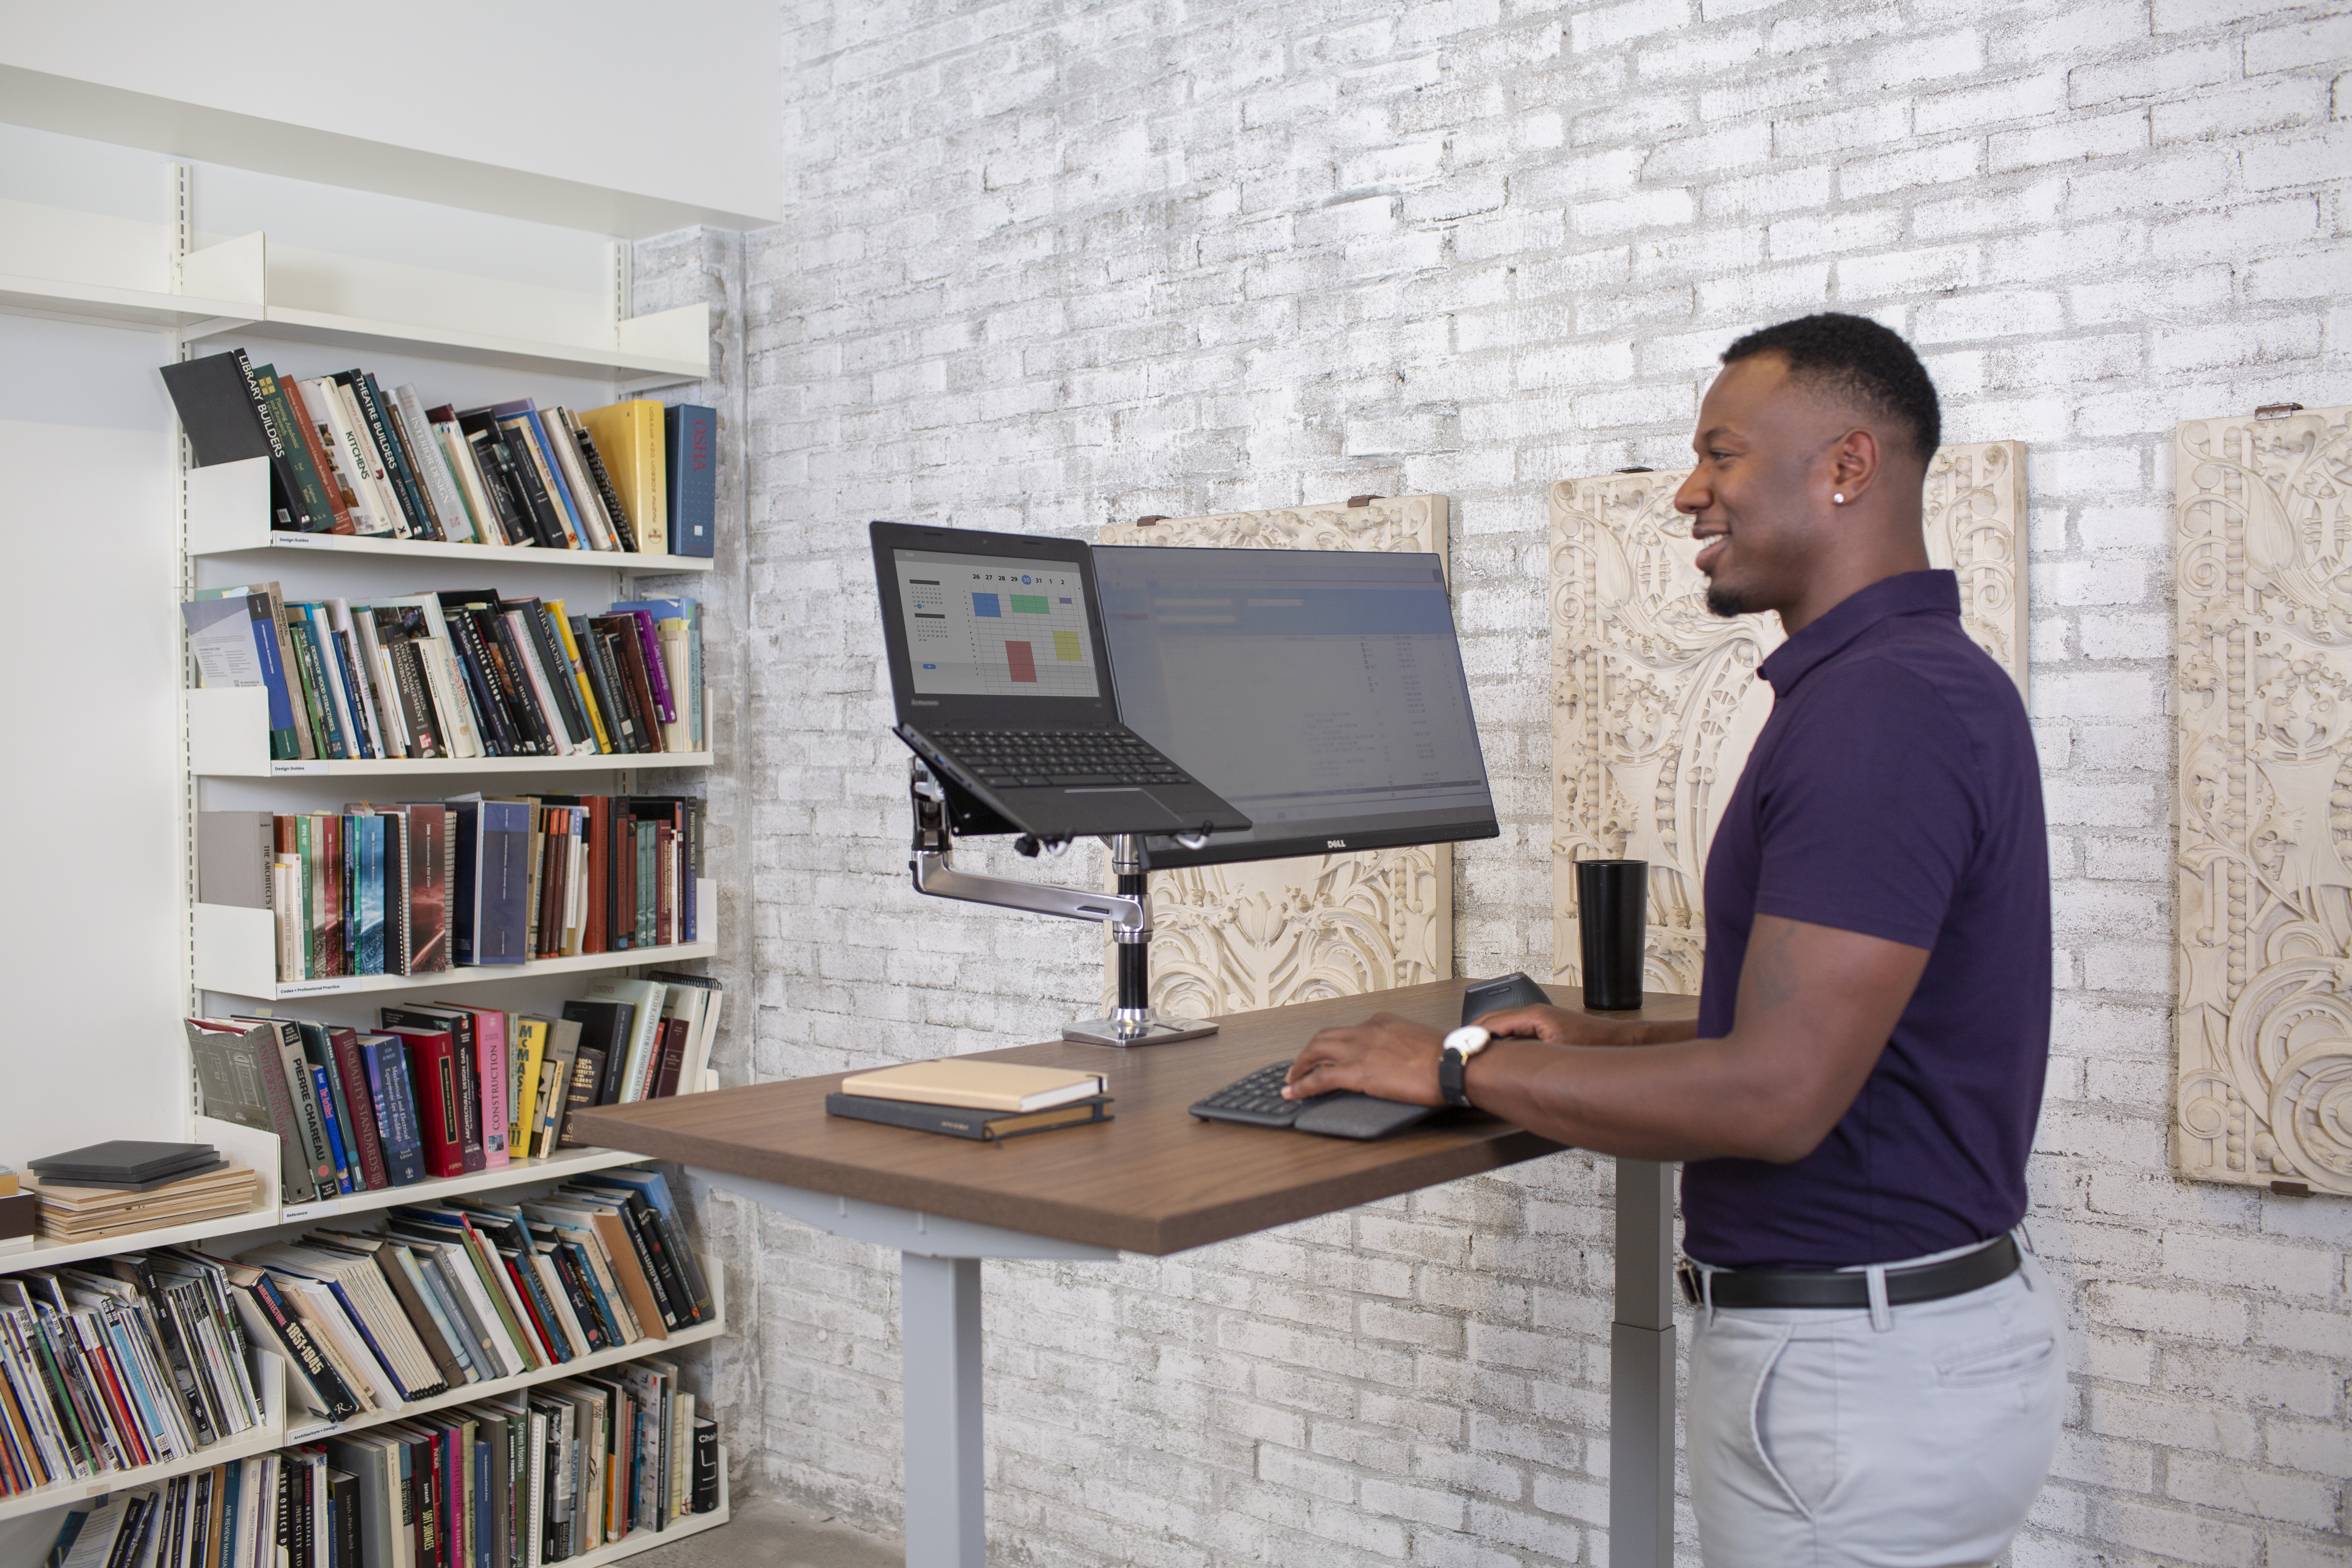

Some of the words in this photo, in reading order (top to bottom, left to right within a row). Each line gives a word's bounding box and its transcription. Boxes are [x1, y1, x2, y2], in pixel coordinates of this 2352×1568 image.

[238, 354, 263, 402] LIBRARY
[256, 403, 285, 458] BUILDERS
[272, 407, 287, 435] Research
[274, 397, 287, 418] Planning
[283, 417, 300, 449] Academic
[355, 374, 378, 421] THEATRE
[373, 421, 397, 470] BUILDERS
[346, 396, 359, 417] History
[357, 423, 370, 445] Modern
[365, 445, 378, 466] Design
[693, 419, 706, 471] OSHA
[345, 430, 369, 480] KITCHENS
[411, 415, 434, 464] INTERIOR
[429, 465, 450, 504] DESIGN
[395, 478, 407, 497] JAMES
[403, 496, 414, 516] STEELE
[272, 595, 281, 622] Alejandro
[278, 623, 286, 646] Aravena
[278, 603, 288, 636] ELEMENTAL
[536, 607, 552, 637] THOS.
[548, 637, 565, 674] MOSER
[310, 645, 319, 667] DESIGN
[398, 642, 408, 661] AND
[459, 629, 473, 655] Stadia
[463, 610, 475, 630] NEW
[472, 633, 488, 665] OFFICE
[484, 668, 501, 702] DESIGN
[315, 666, 321, 674] OF
[317, 675, 326, 693] WOOD
[391, 644, 411, 694] HANDBOOK
[403, 640, 417, 677] FACILITY
[414, 679, 427, 710] DESIGN
[422, 648, 430, 670] MATERIAL
[428, 671, 437, 698] STRATEGIES
[443, 658, 453, 677] Kinetic
[448, 678, 464, 723] Architecture
[450, 657, 469, 707] WorkScape
[509, 661, 521, 683] CITY
[518, 685, 531, 711] HOME
[322, 694, 335, 731] STRUCTURES
[402, 662, 424, 723] MANAGEMENT
[1327, 840, 1346, 848] DELL
[257, 1043, 270, 1066] AND
[326, 1037, 334, 1058] DETAIL
[330, 1060, 338, 1078] Building
[262, 1064, 278, 1095] DESIGN
[267, 1039, 283, 1077] INTERIOR
[276, 1078, 294, 1118] GRAPHIC
[319, 1087, 329, 1098] The
[490, 1045, 499, 1130] CONSTRUCTION
[269, 1096, 290, 1147] STANDARDS
[293, 1058, 310, 1100] PIERRE
[304, 1102, 325, 1160] CHAREAU
[321, 1097, 334, 1118] Architect
[345, 1050, 365, 1100] QUALITY
[358, 1103, 379, 1172] STANDARDS
[384, 1068, 395, 1100] Equipment
[392, 1113, 402, 1142] Buildings
[391, 1065, 402, 1099] Mechanical
[400, 1111, 410, 1139] Electrical
[438, 1249, 456, 1278] PALLADIO
[624, 1207, 637, 1231] Essential
[635, 1233, 647, 1255] FRANK
[643, 1255, 656, 1276] LLOYD
[651, 1274, 667, 1302] WRIGHT
[53, 1286, 62, 1300] INTERIOR
[256, 1283, 287, 1327] ARCHITECTURE
[261, 1277, 283, 1306] MODERN
[437, 1280, 446, 1293] PAUL
[444, 1292, 456, 1310] TUTTLE
[453, 1309, 467, 1330] DESIGNS
[47, 1308, 56, 1320] 09/10
[284, 1321, 325, 1375] 1851-1945
[293, 1429, 320, 1440] Architecture
[161, 1510, 170, 1536] Architectural
[401, 1481, 409, 1524] SURFACES
[422, 1510, 433, 1523] SOFT
[111, 1550, 122, 1568] Systems
[118, 1528, 130, 1550] Structural
[158, 1537, 166, 1552] History
[423, 1524, 434, 1550] SURFACES
